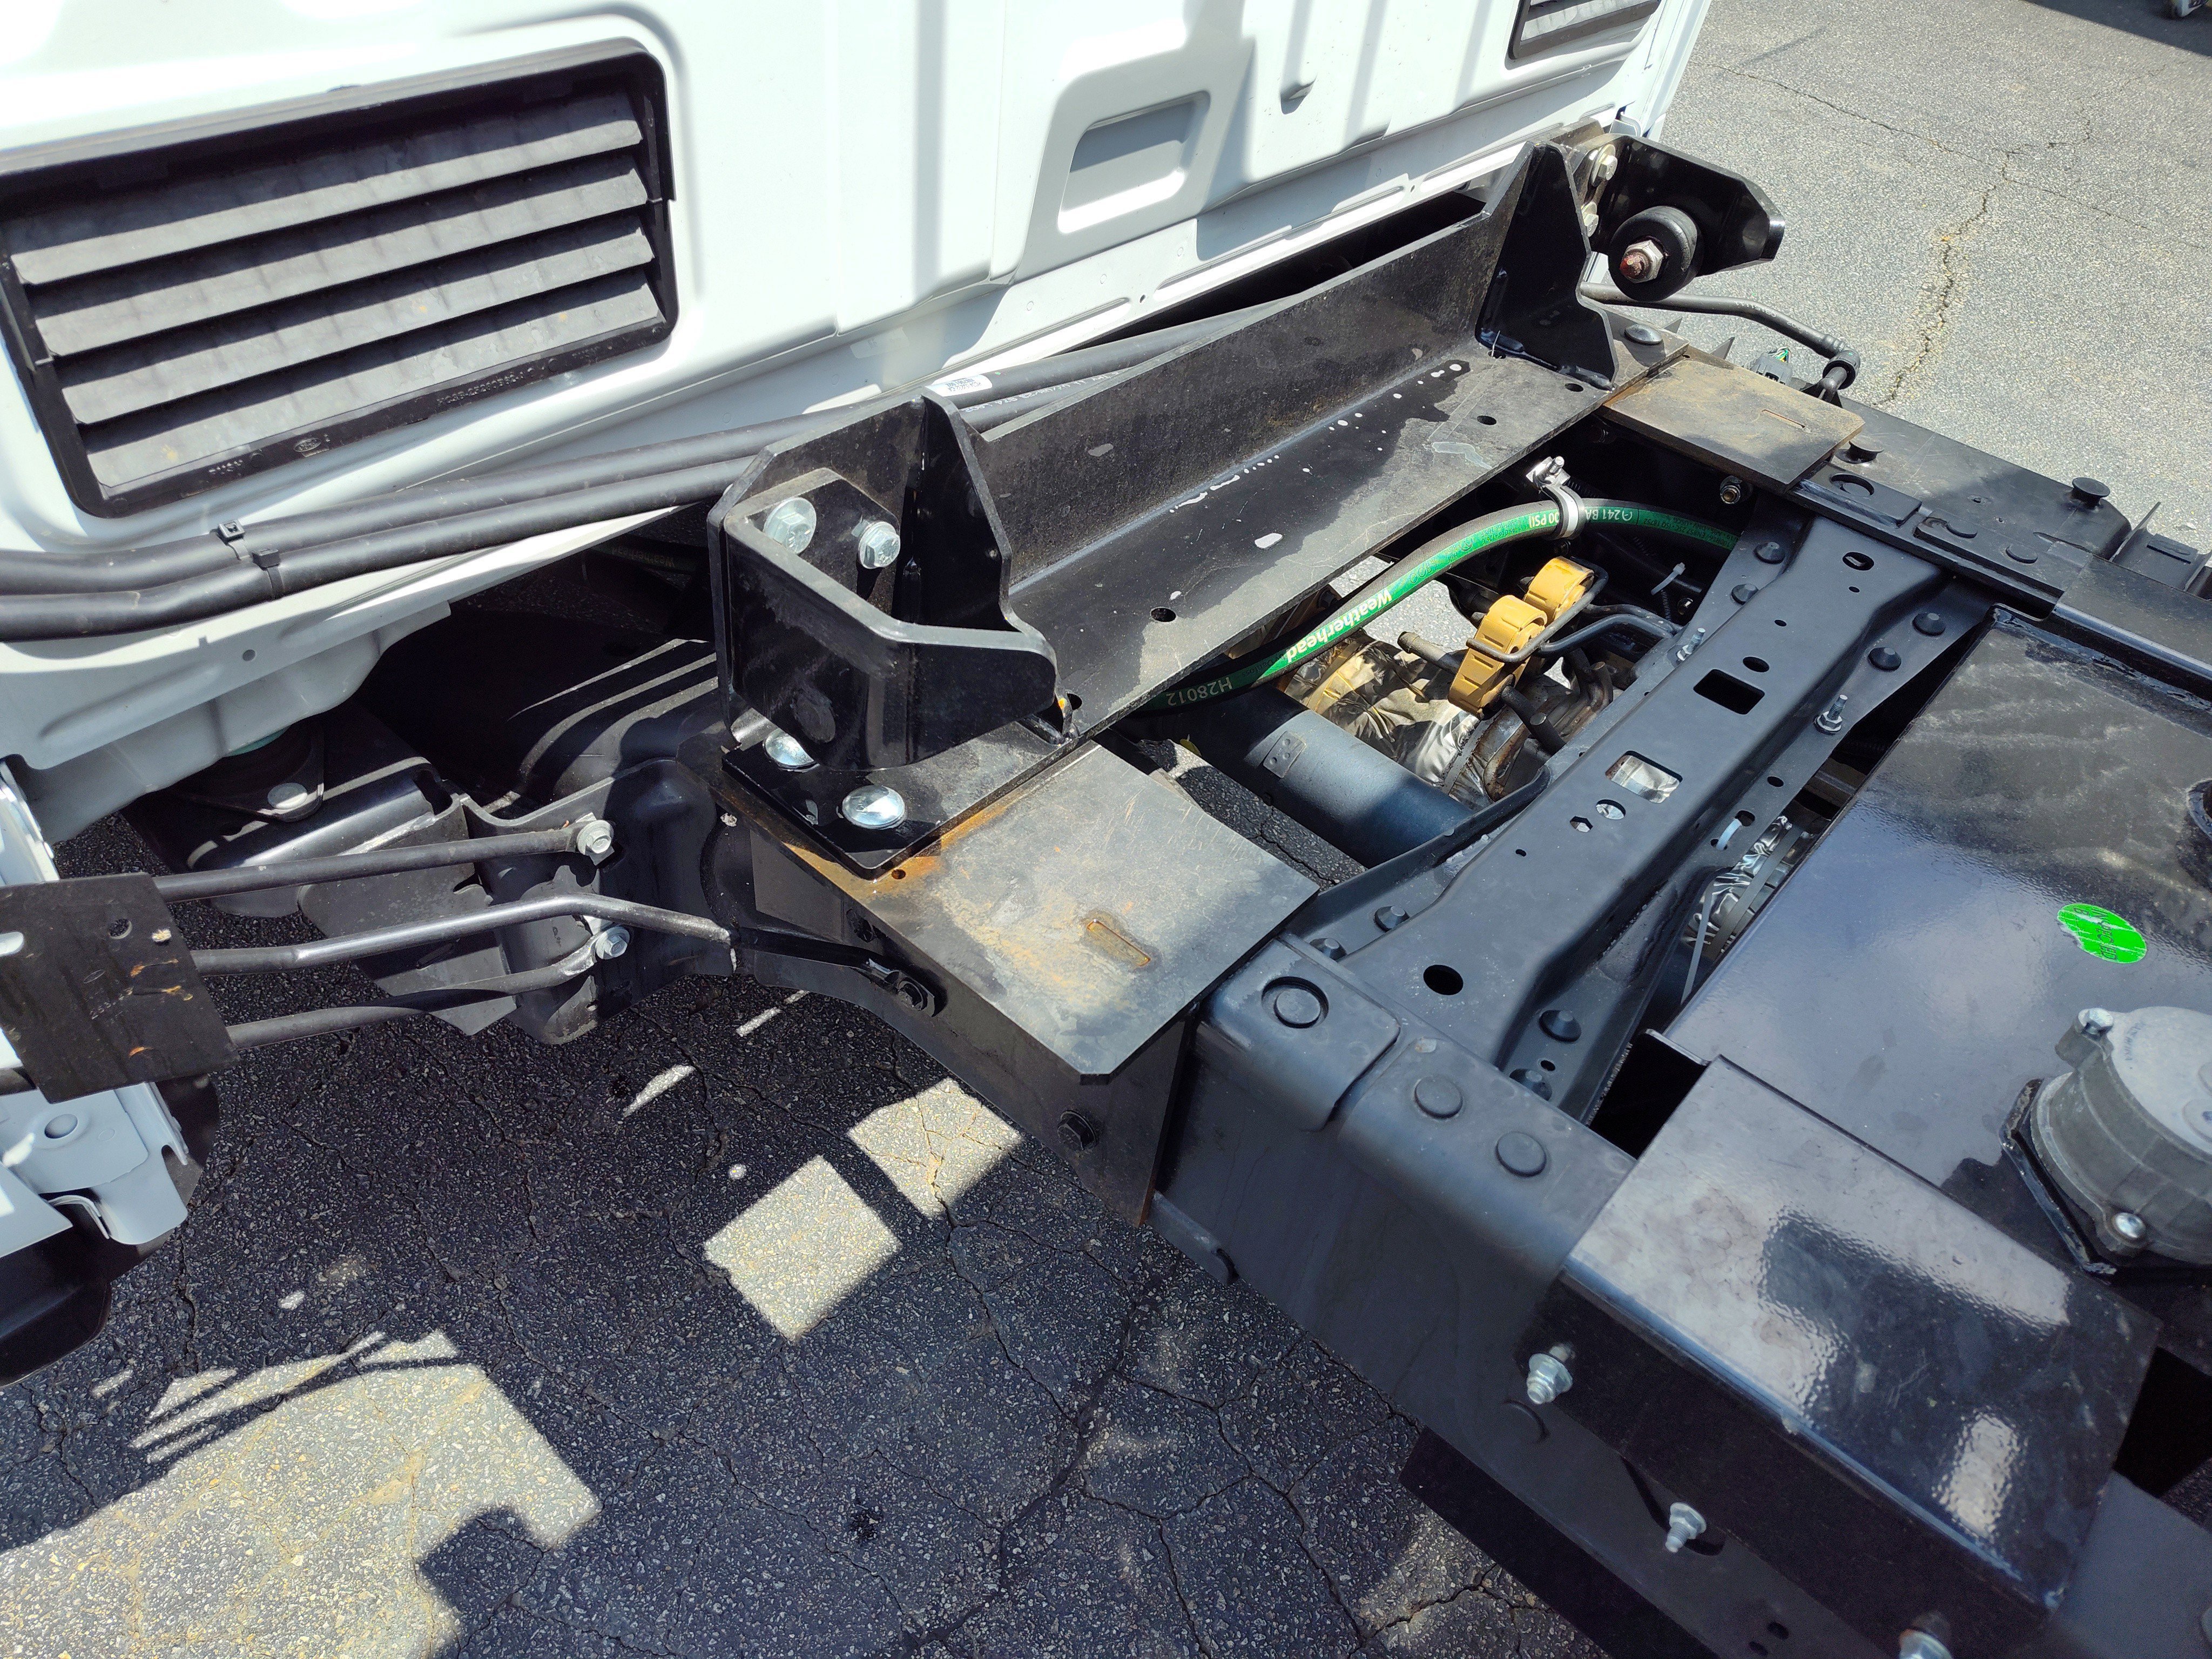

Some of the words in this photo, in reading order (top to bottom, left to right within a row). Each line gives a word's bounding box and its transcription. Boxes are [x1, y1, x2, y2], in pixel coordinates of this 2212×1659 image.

[1586, 508, 1598, 520] BA
[1601, 509, 1620, 521] 241
[1285, 588, 1392, 663] Weatherhead
[1166, 677, 1233, 706] H28012
[2090, 908, 2118, 961] INPECED
